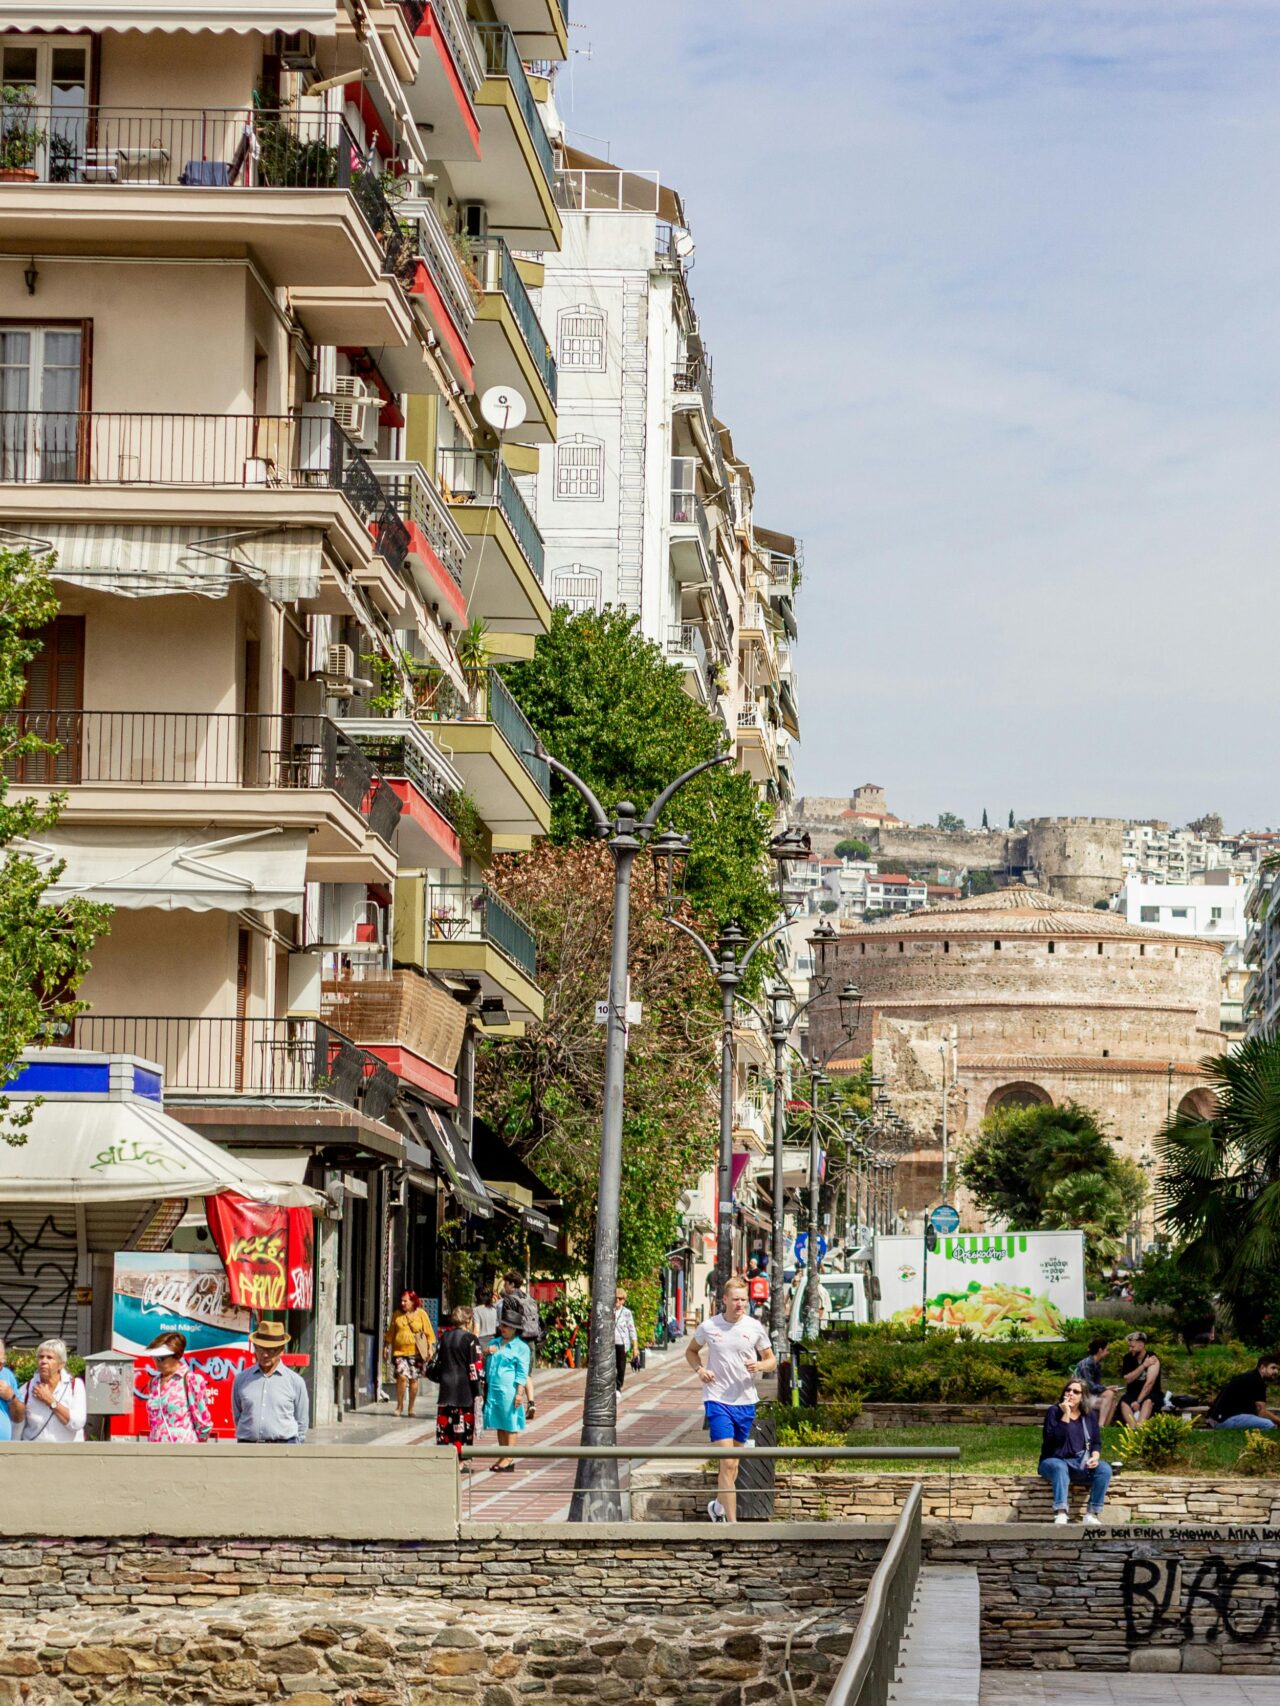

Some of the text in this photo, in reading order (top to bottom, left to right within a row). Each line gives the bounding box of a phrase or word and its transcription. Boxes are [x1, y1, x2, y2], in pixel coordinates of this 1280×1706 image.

[1050, 1274, 1060, 1283] 24
[160, 1323, 201, 1332] Real Magic
